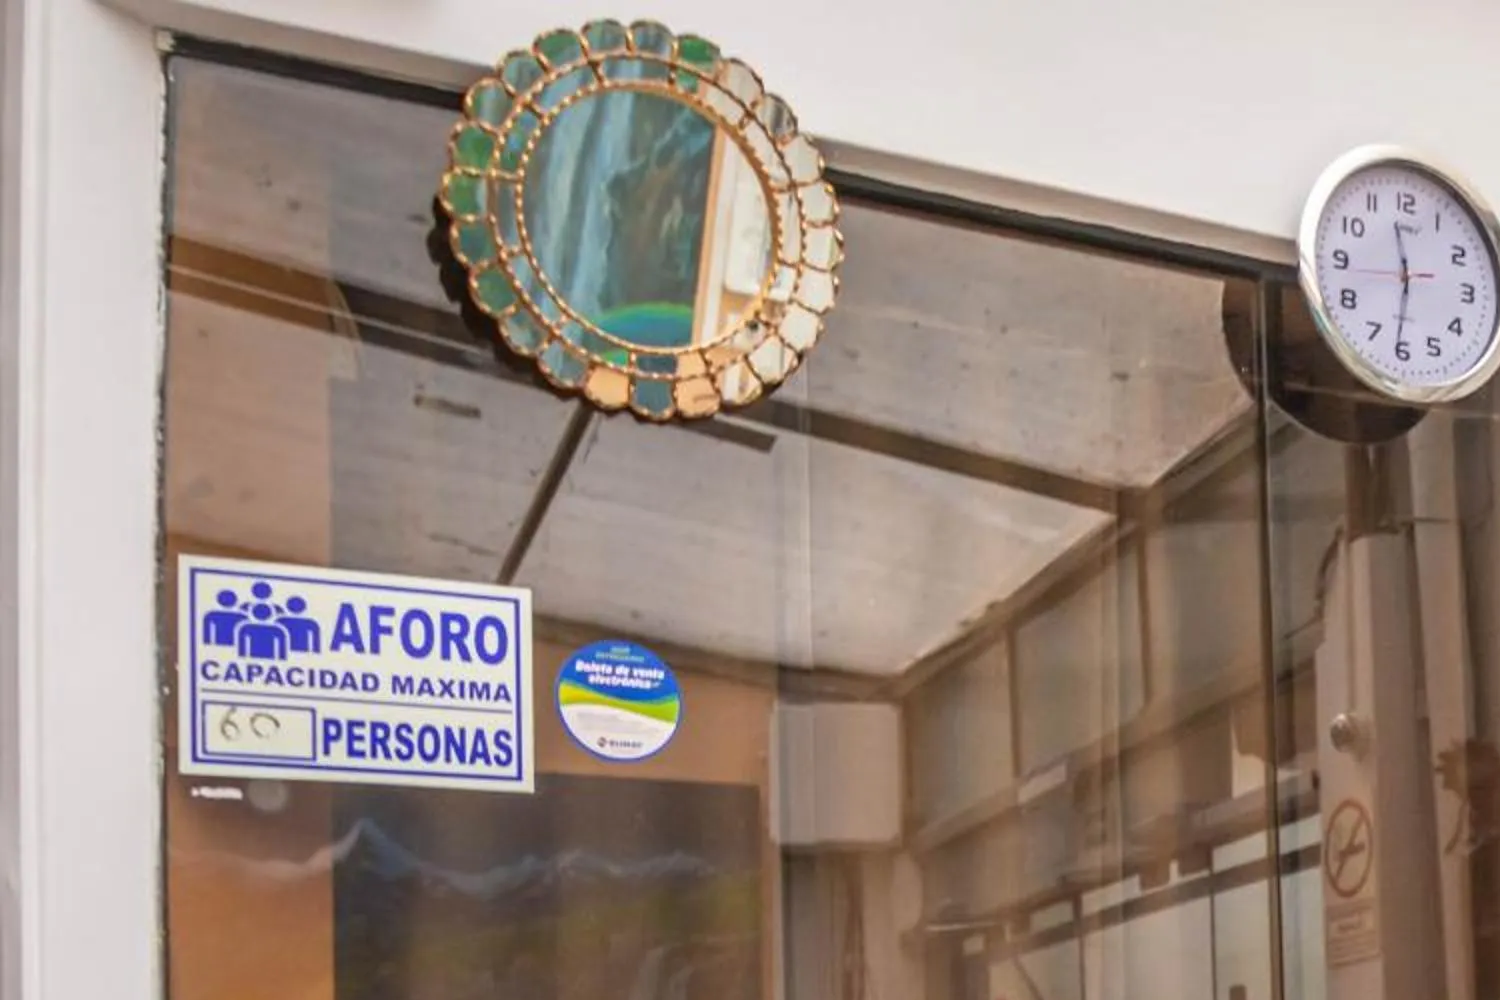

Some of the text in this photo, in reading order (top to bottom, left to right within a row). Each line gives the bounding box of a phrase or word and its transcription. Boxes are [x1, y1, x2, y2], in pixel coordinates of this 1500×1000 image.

[1366, 192, 1378, 213] 11
[1396, 191, 1417, 215] 12
[1342, 215, 1366, 238] 10
[1434, 212, 1441, 234] 1
[1332, 248, 1349, 271] 9
[1450, 244, 1467, 267] 2
[1340, 288, 1358, 311] 8
[1460, 282, 1476, 305] 3
[1365, 321, 1383, 342] 7
[1447, 316, 1464, 337] 4
[1394, 341, 1412, 362] 6
[1426, 336, 1442, 358] 5
[330, 602, 509, 665] AFORO
[201, 660, 512, 703] CAPACIDAD MAXIMA
[321, 717, 513, 768] PERSONAS
